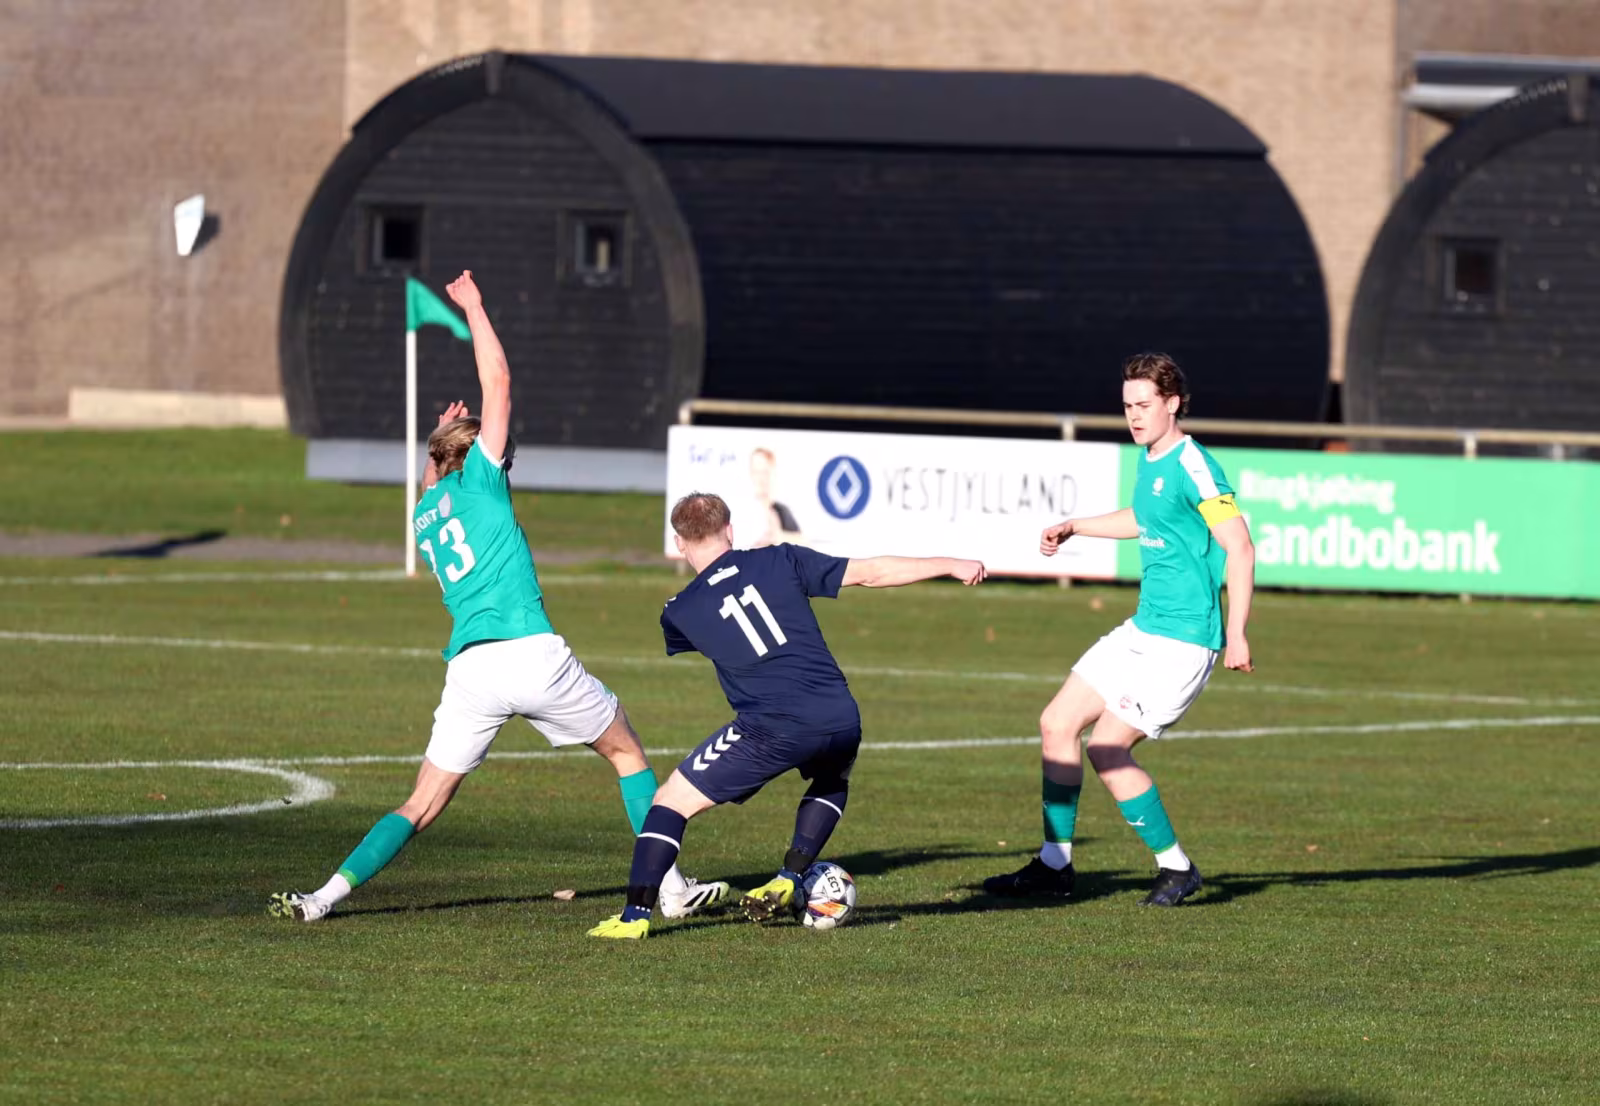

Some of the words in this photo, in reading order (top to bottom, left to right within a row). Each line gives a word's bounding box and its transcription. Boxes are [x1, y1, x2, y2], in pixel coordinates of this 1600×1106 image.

[883, 465, 1078, 520] VESTJYLLAND
[419, 517, 477, 592] 13
[1241, 512, 1501, 573] andbobank
[718, 584, 788, 657] 11
